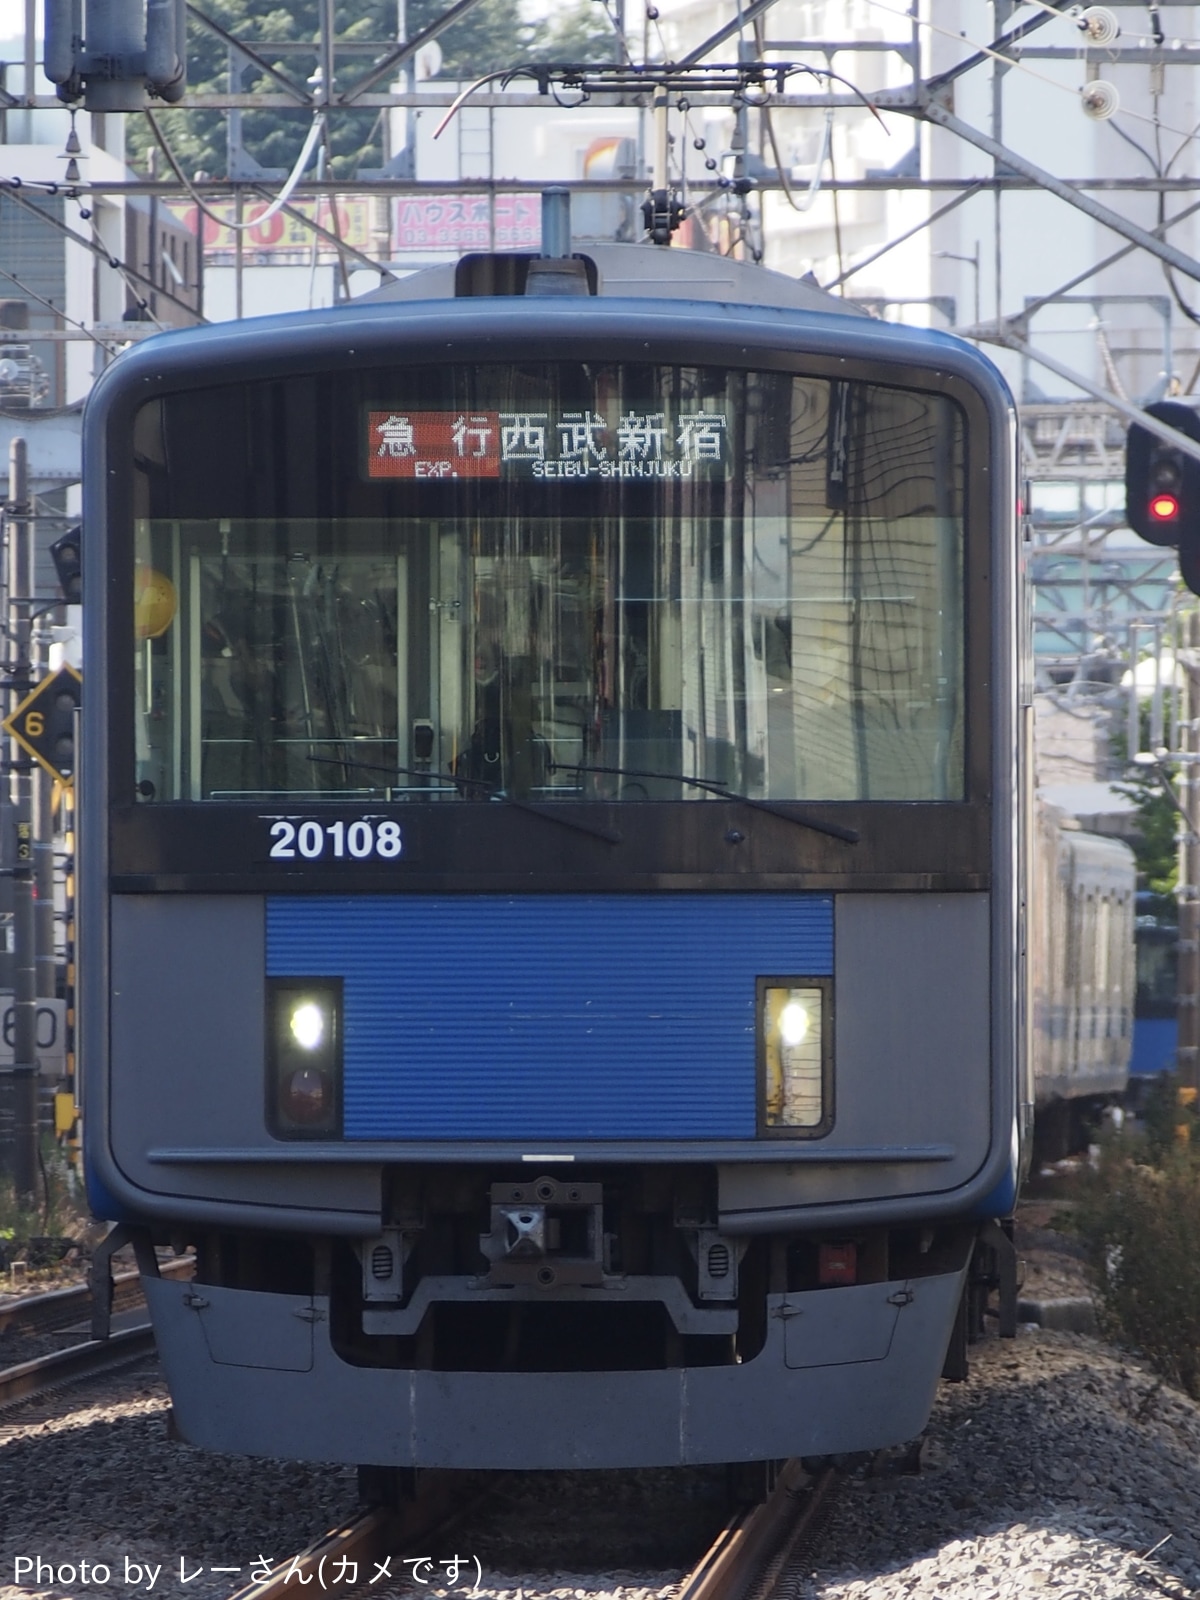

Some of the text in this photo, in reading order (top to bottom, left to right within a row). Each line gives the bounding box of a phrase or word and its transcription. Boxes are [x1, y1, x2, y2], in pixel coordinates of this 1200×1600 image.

[376, 410, 726, 460] 急行 西武新宿
[415, 460, 693, 478] EXP. SEIBU-SHINJUKU
[25, 712, 45, 736] 6
[269, 820, 402, 858] 20108
